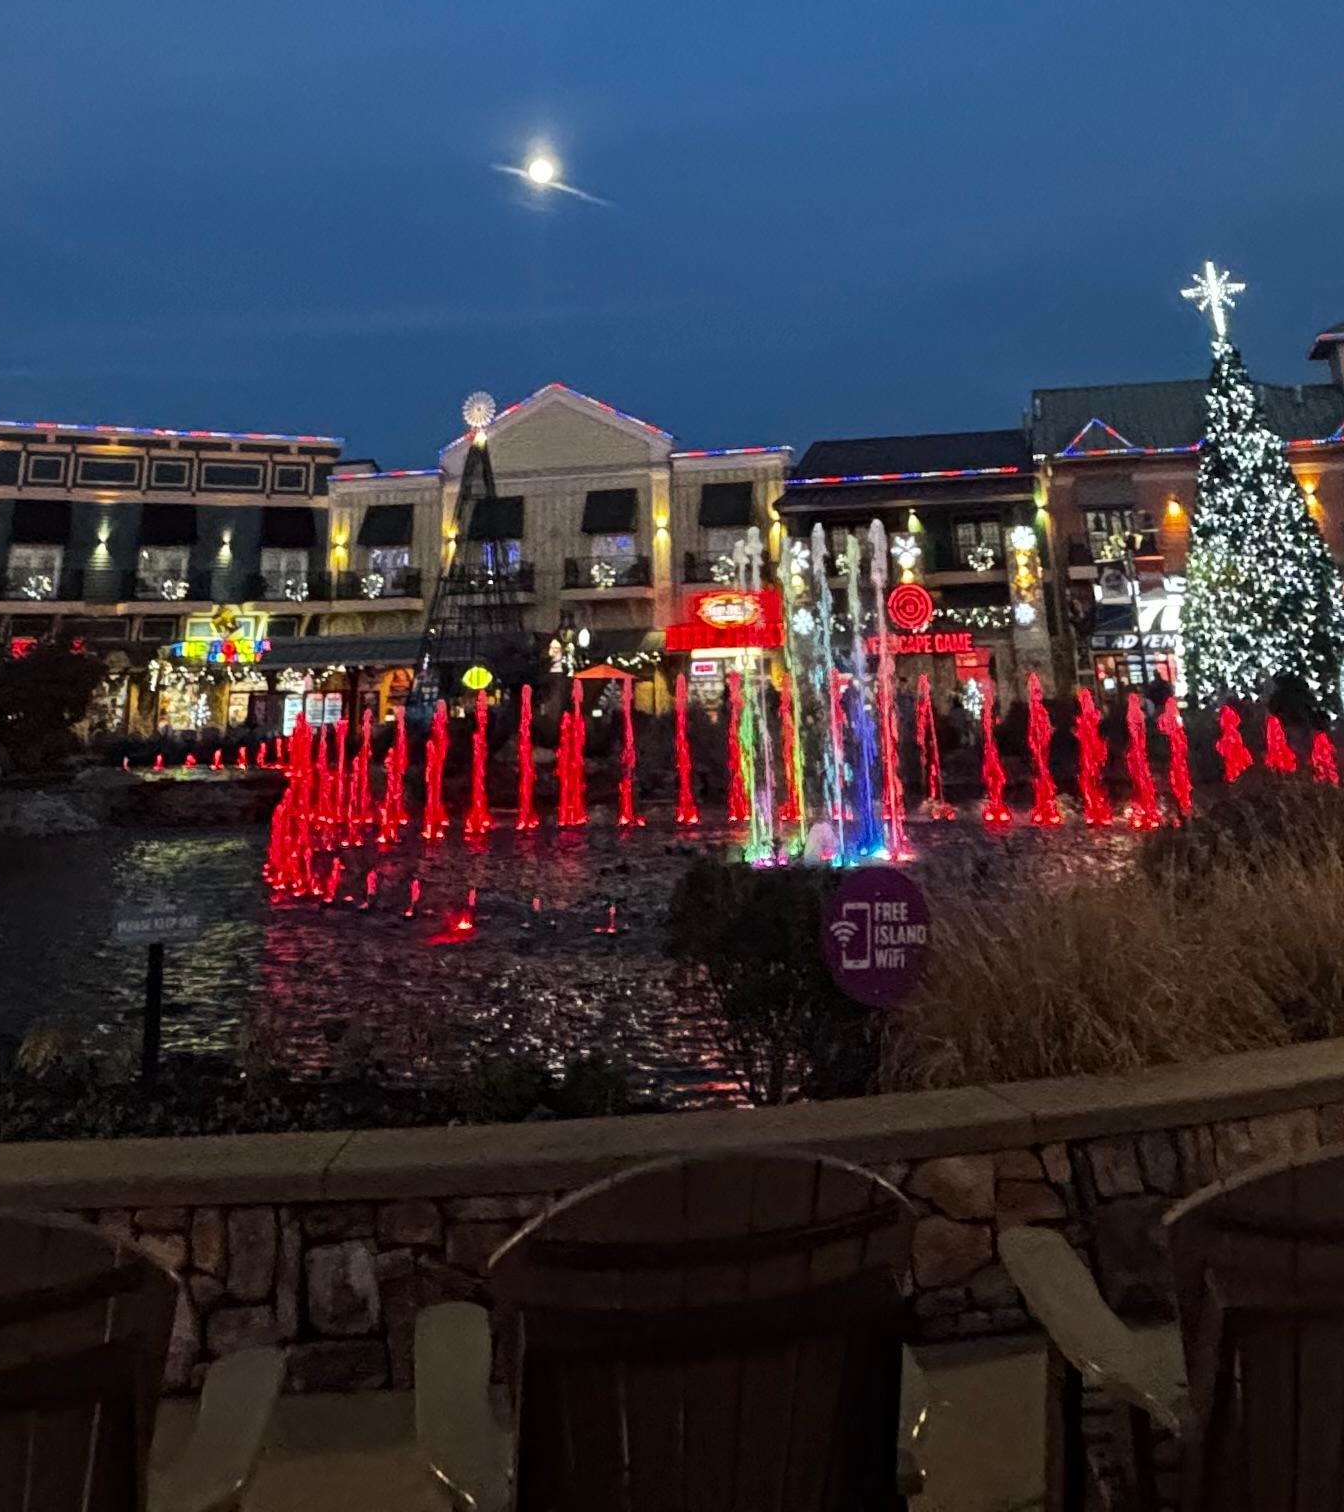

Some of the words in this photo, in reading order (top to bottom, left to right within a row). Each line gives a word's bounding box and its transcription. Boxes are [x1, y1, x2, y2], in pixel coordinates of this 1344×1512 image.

[935, 633, 973, 653] GAME
[874, 902, 909, 922] FREE
[874, 925, 927, 944] ISLAND
